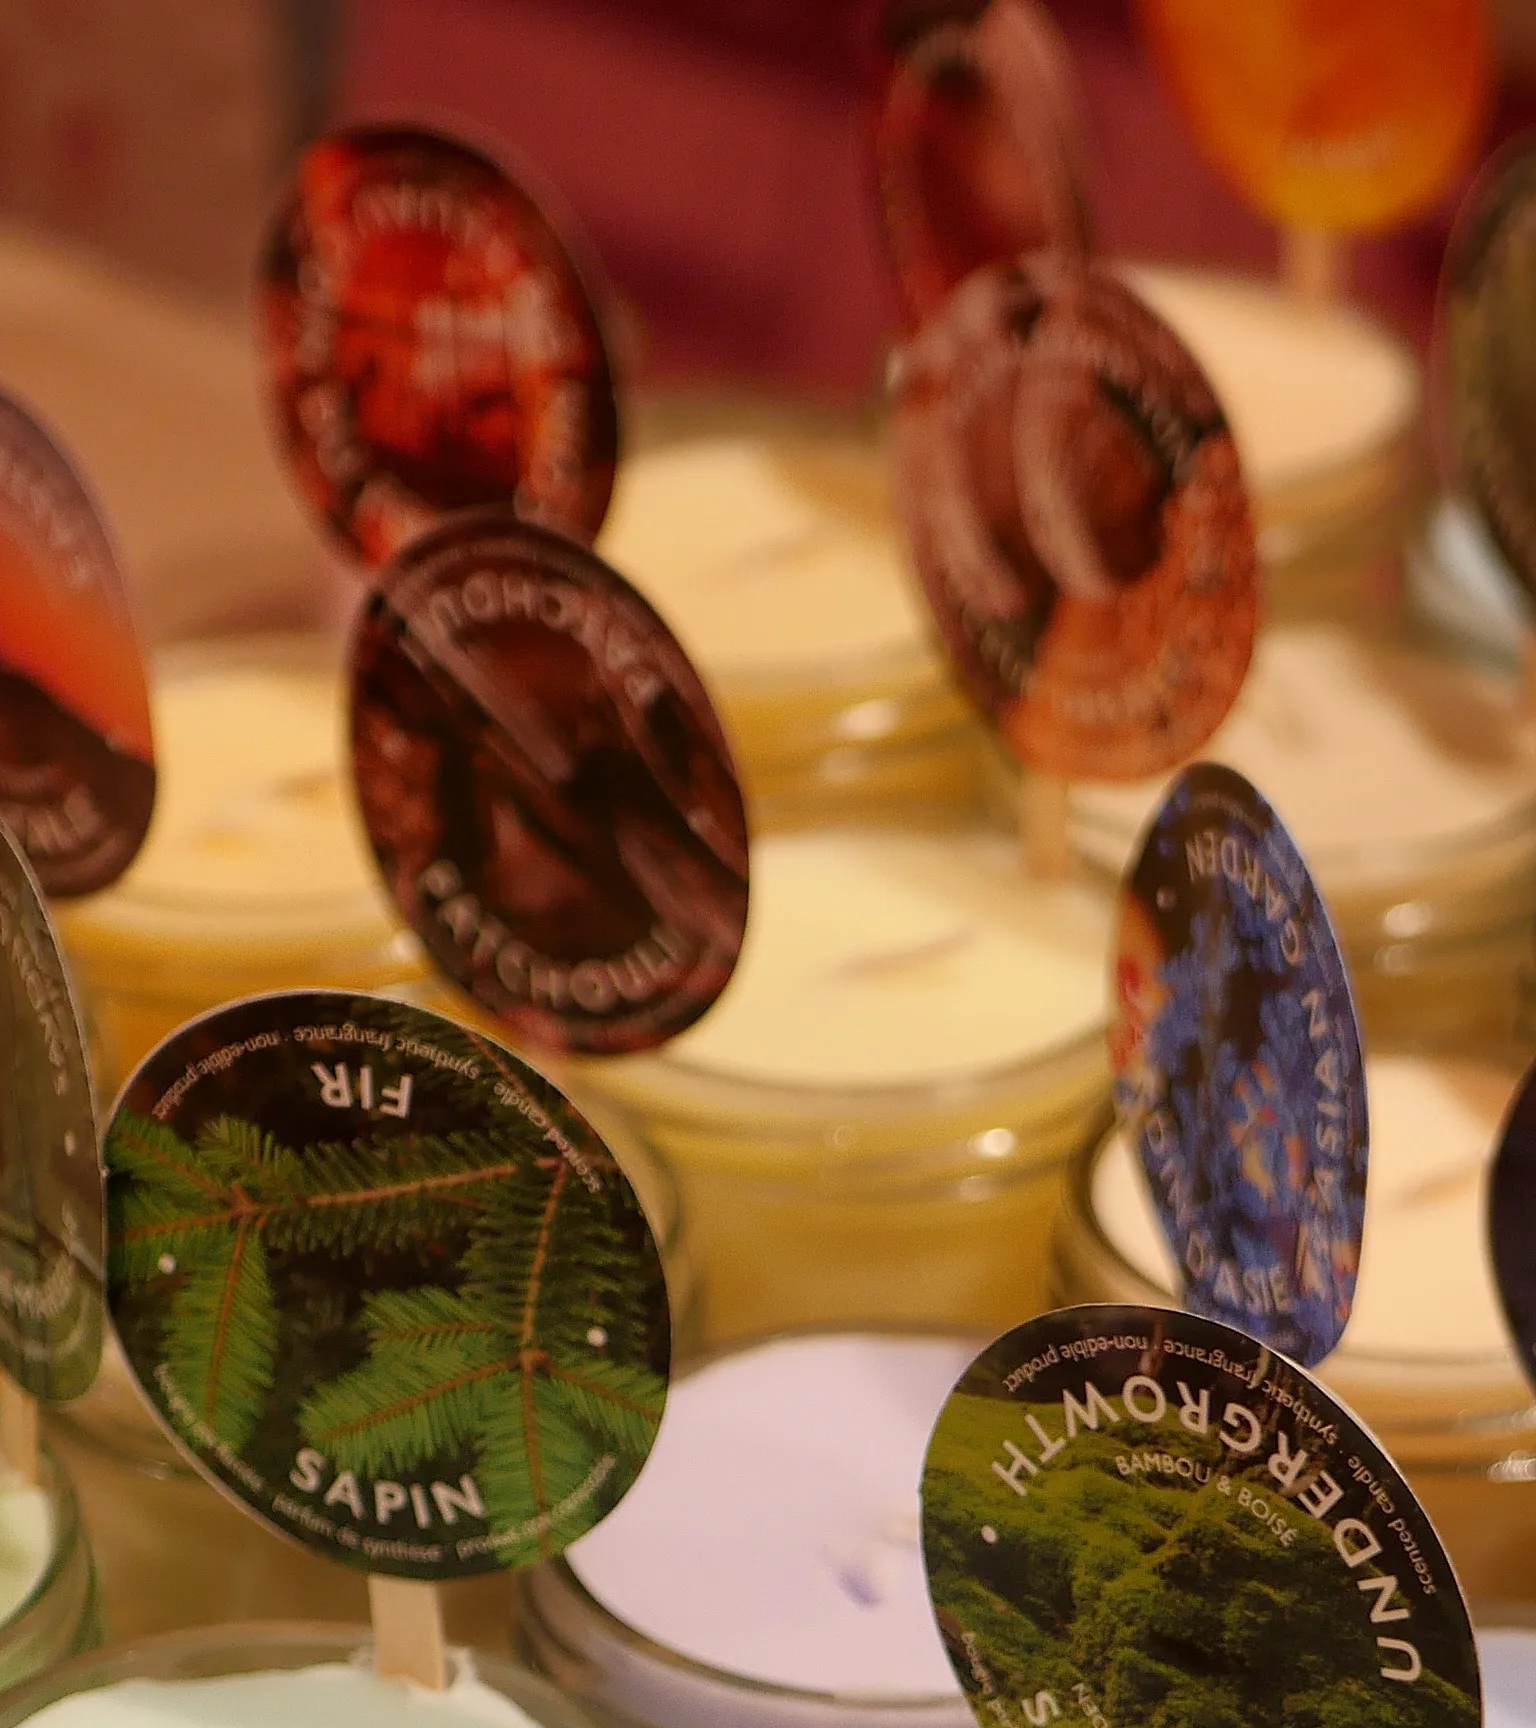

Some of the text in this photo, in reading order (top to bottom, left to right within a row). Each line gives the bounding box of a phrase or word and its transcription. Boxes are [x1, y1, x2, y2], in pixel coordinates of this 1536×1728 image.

[1184, 833, 1347, 1212] ASIAN GARDEN
[311, 1062, 414, 1119] FIR
[493, 1081, 547, 1127] candle
[1001, 1346, 1059, 1394] product
[1058, 1334, 1149, 1360] non-edible
[1259, 1377, 1338, 1444] synthetic
[289, 1447, 486, 1530] SAPIN
[1114, 1450, 1211, 1486] BAMBOU
[1215, 1478, 1233, 1498] &
[1347, 1454, 1396, 1515] candle
[991, 1374, 1423, 1682] UNDERGROWTH
[1387, 1516, 1436, 1595] scented
